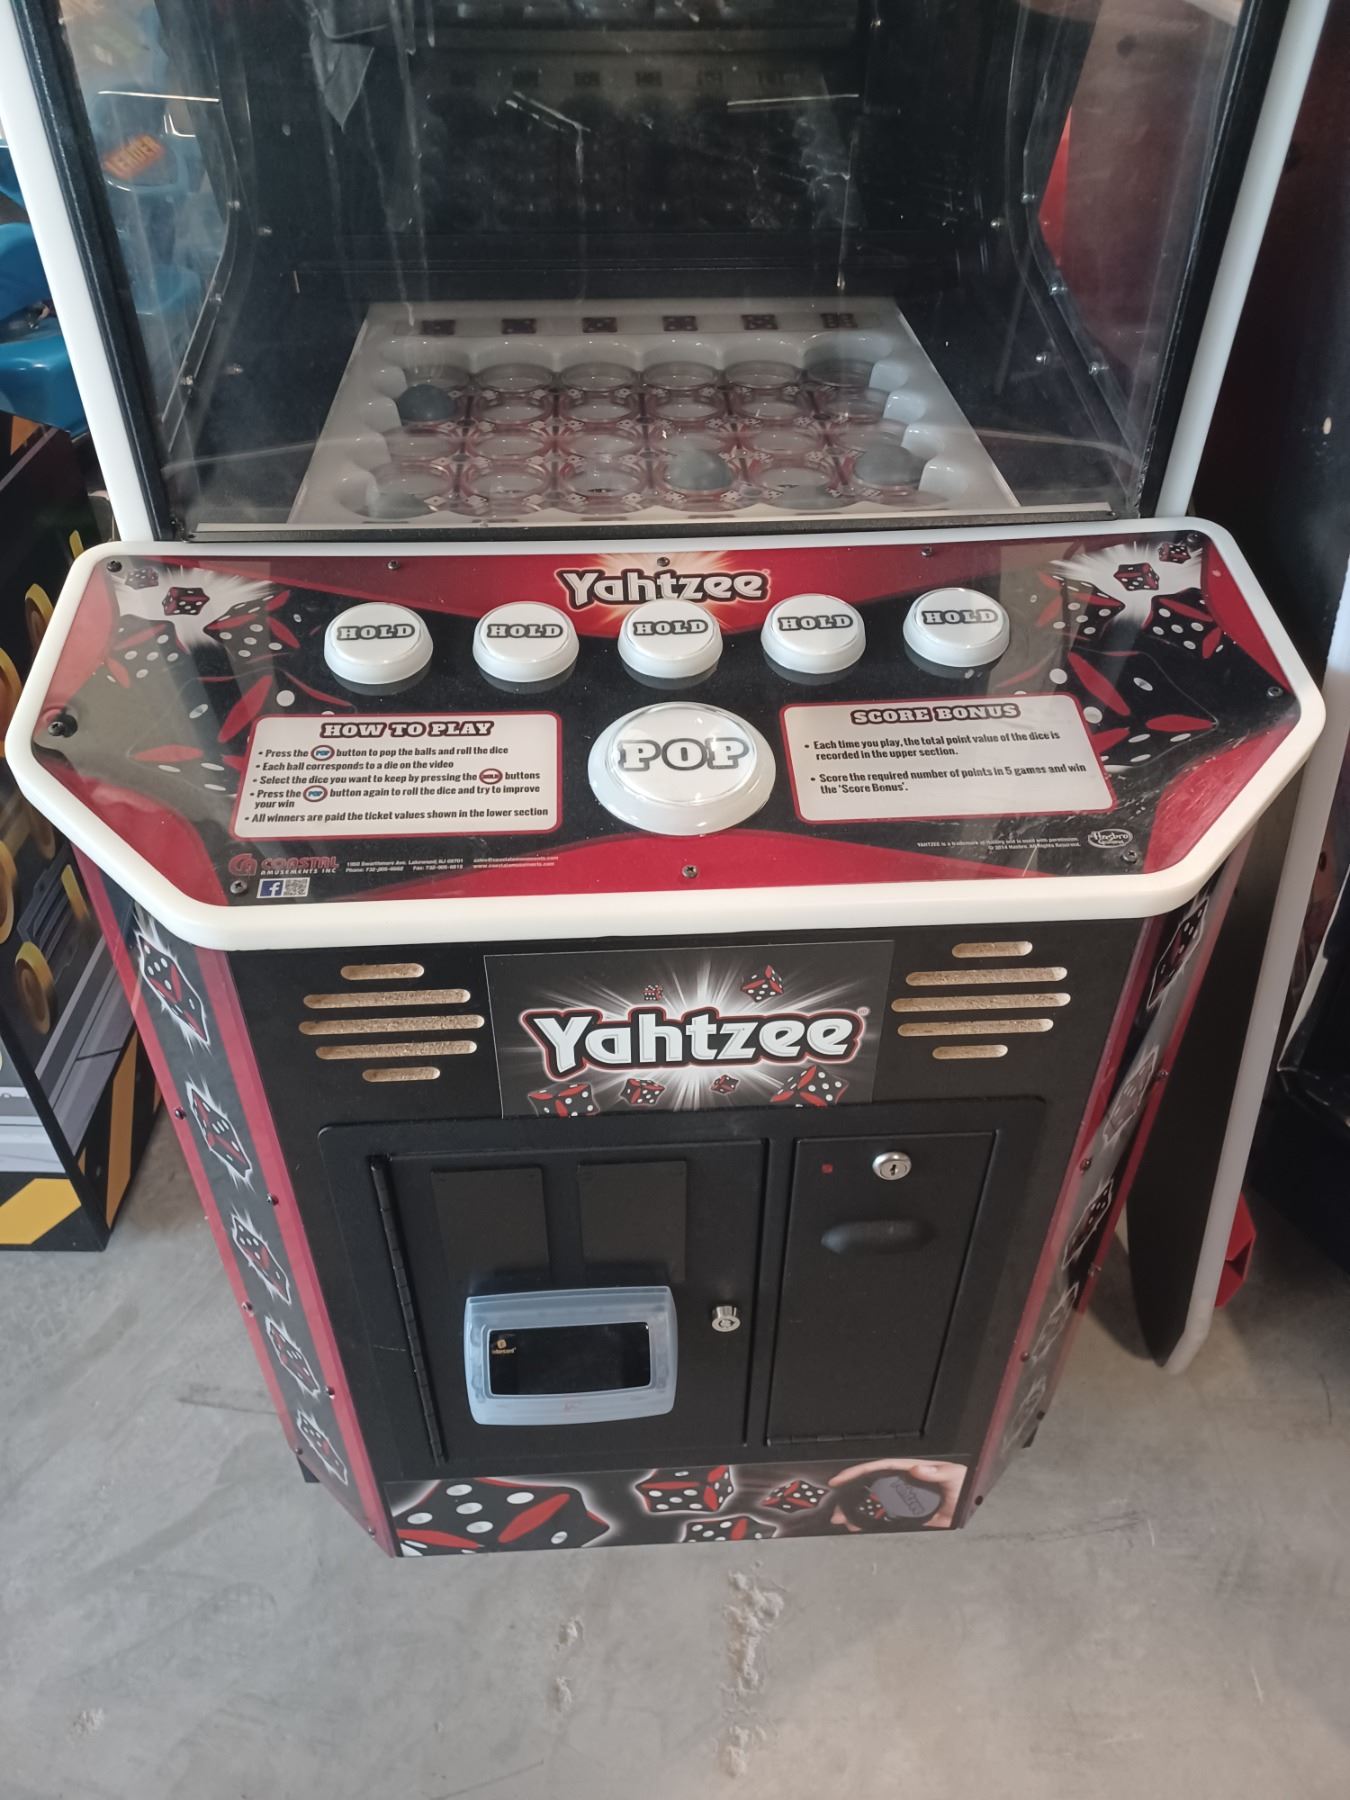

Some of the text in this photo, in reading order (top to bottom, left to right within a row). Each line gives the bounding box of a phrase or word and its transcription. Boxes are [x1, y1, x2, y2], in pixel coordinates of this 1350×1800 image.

[557, 566, 770, 610] Yahtzee
[775, 613, 854, 633] HOLD
[922, 609, 1000, 626] HOLD
[336, 621, 417, 641] HOLD
[485, 621, 564, 639] HOLD
[632, 619, 709, 636] HOLD
[850, 703, 1021, 725] SCORE BONUS
[320, 720, 495, 738] HOW TO PLAY
[813, 730, 1061, 751] Each time you play, the total point value of the dice is
[265, 749, 292, 758] Press
[293, 748, 308, 757] the
[336, 748, 367, 757] button
[369, 748, 378, 757] to
[379, 749, 397, 759] pop
[398, 748, 413, 756] the
[414, 747, 436, 756] balls
[438, 746, 455, 755] and
[456, 746, 472, 755] roll
[473, 746, 488, 754] the
[489, 745, 508, 754] dice
[617, 737, 749, 771] POP
[816, 747, 959, 761] recorded in the upper section.
[262, 762, 285, 771] Each
[286, 761, 305, 770] ball
[306, 761, 364, 772] corresponds
[365, 761, 376, 769] to
[384, 760, 398, 769] die
[412, 761, 428, 769] the
[429, 760, 454, 768] video
[819, 763, 1087, 783] Score the required number of points in 5 games and win
[259, 776, 290, 785] Select
[291, 775, 307, 784] the
[308, 775, 329, 784] dice
[330, 777, 347, 786] you
[373, 775, 383, 783] to
[384, 775, 407, 785] keep
[408, 774, 419, 784] by
[420, 774, 461, 784] pressing
[462, 773, 477, 781] the
[505, 772, 541, 780] buttons
[256, 790, 284, 799] Press
[285, 789, 301, 798] the
[329, 788, 361, 797] button
[362, 789, 389, 799] again
[390, 788, 401, 796] to
[402, 787, 419, 796] roll
[420, 787, 436, 795] the
[437, 786, 457, 795] dice
[458, 786, 476, 794] and
[477, 786, 491, 795] try
[491, 786, 502, 794] to
[503, 785, 541, 794] improve
[820, 785, 838, 794] the
[254, 800, 296, 810] your win
[251, 814, 267, 823] All
[267, 814, 305, 822] winners
[325, 812, 347, 823] paid
[348, 812, 365, 821] the
[364, 811, 393, 821] ticket
[394, 811, 426, 820] values
[427, 809, 457, 819] shown
[458, 809, 469, 818] in
[469, 809, 486, 818] the
[486, 808, 513, 817] lower
[514, 807, 549, 817] section
[261, 857, 339, 870] COASTAL
[261, 868, 318, 876] AMUSEMENTS
[526, 1010, 858, 1078] Yahtzee
